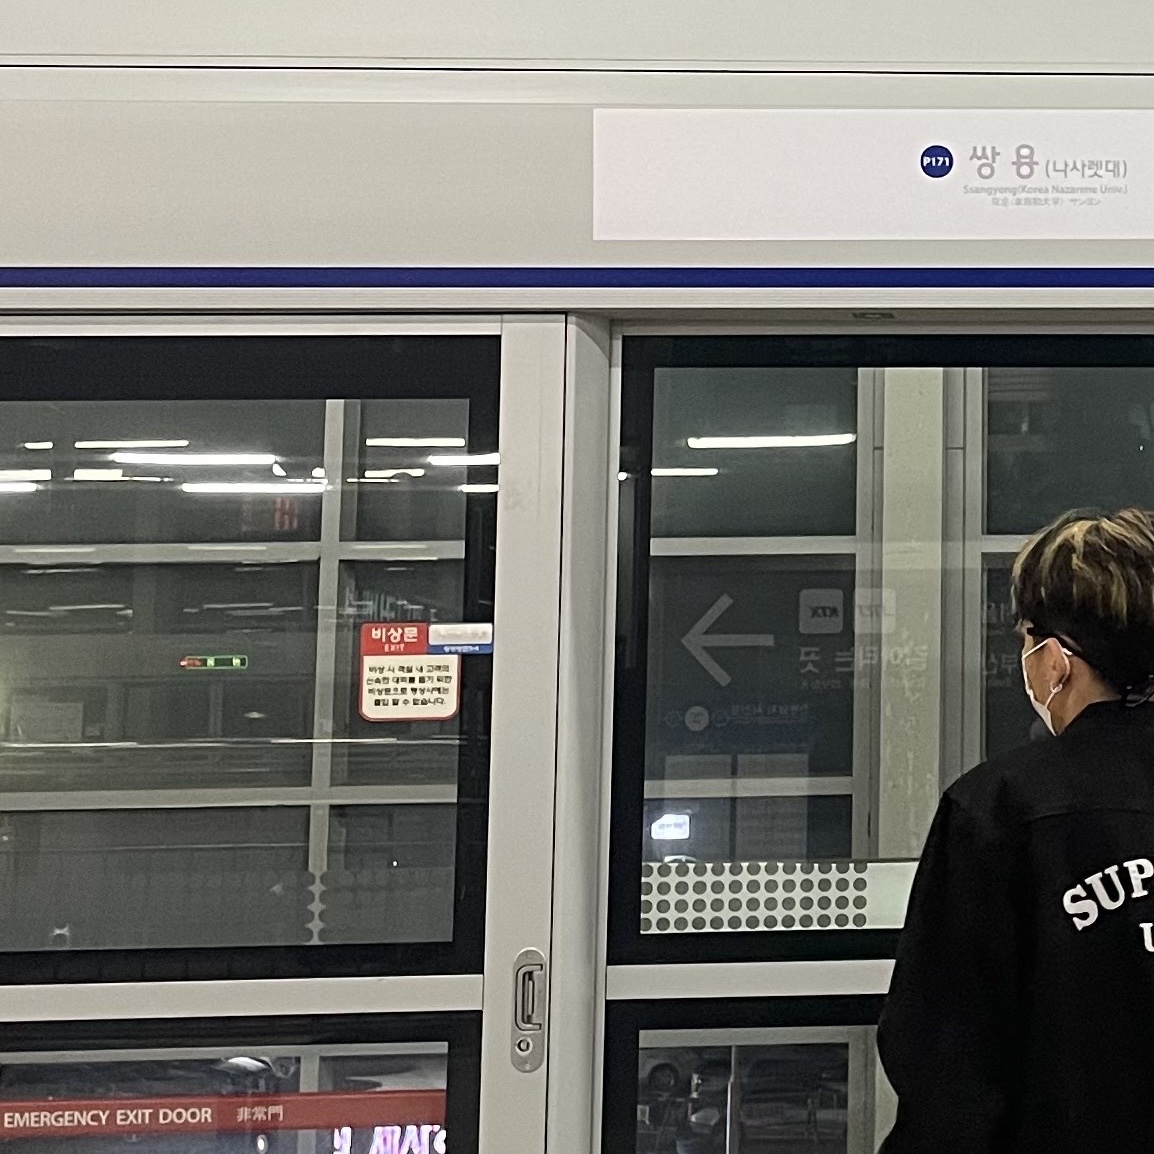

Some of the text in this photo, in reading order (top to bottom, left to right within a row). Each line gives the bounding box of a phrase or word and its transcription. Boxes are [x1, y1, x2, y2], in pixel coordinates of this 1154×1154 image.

[922, 156, 950, 167] P171
[371, 627, 418, 643] 비상문
[3, 1107, 212, 1128] EMERGENCY EXIT DOOR
